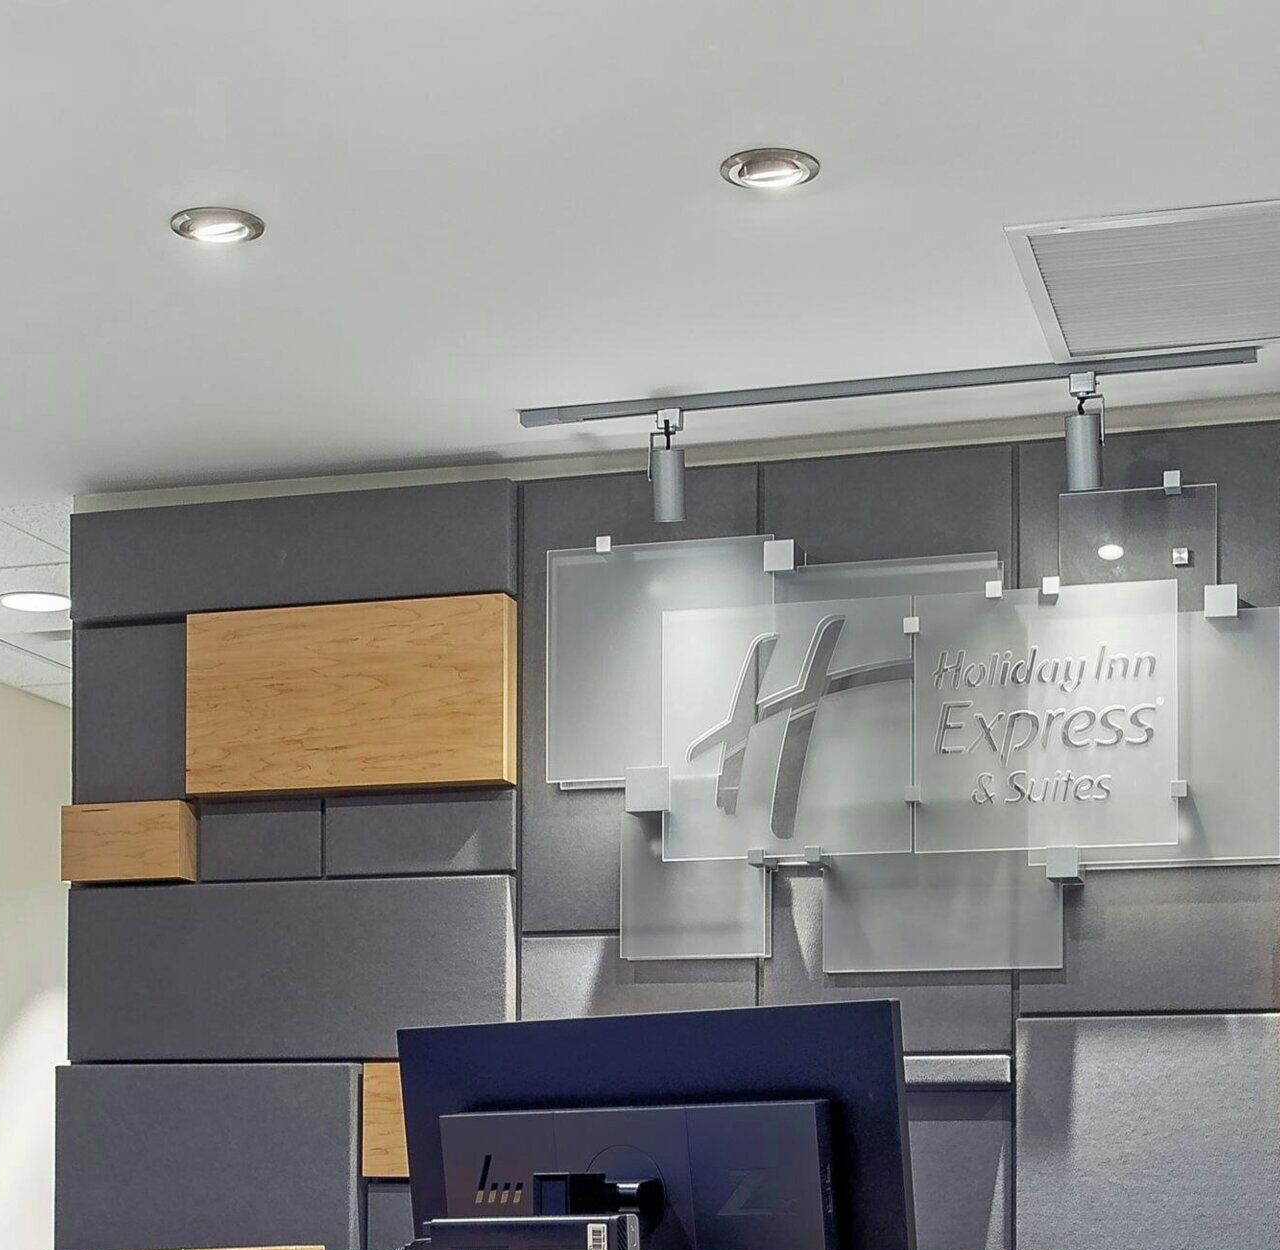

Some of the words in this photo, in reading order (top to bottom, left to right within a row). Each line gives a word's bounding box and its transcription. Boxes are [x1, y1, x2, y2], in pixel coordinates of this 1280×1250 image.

[933, 645, 1087, 693] Holiday
[1095, 641, 1157, 681] Inn
[934, 700, 1157, 767] Express
[971, 772, 996, 805] &
[1004, 769, 1113, 803] Suites
